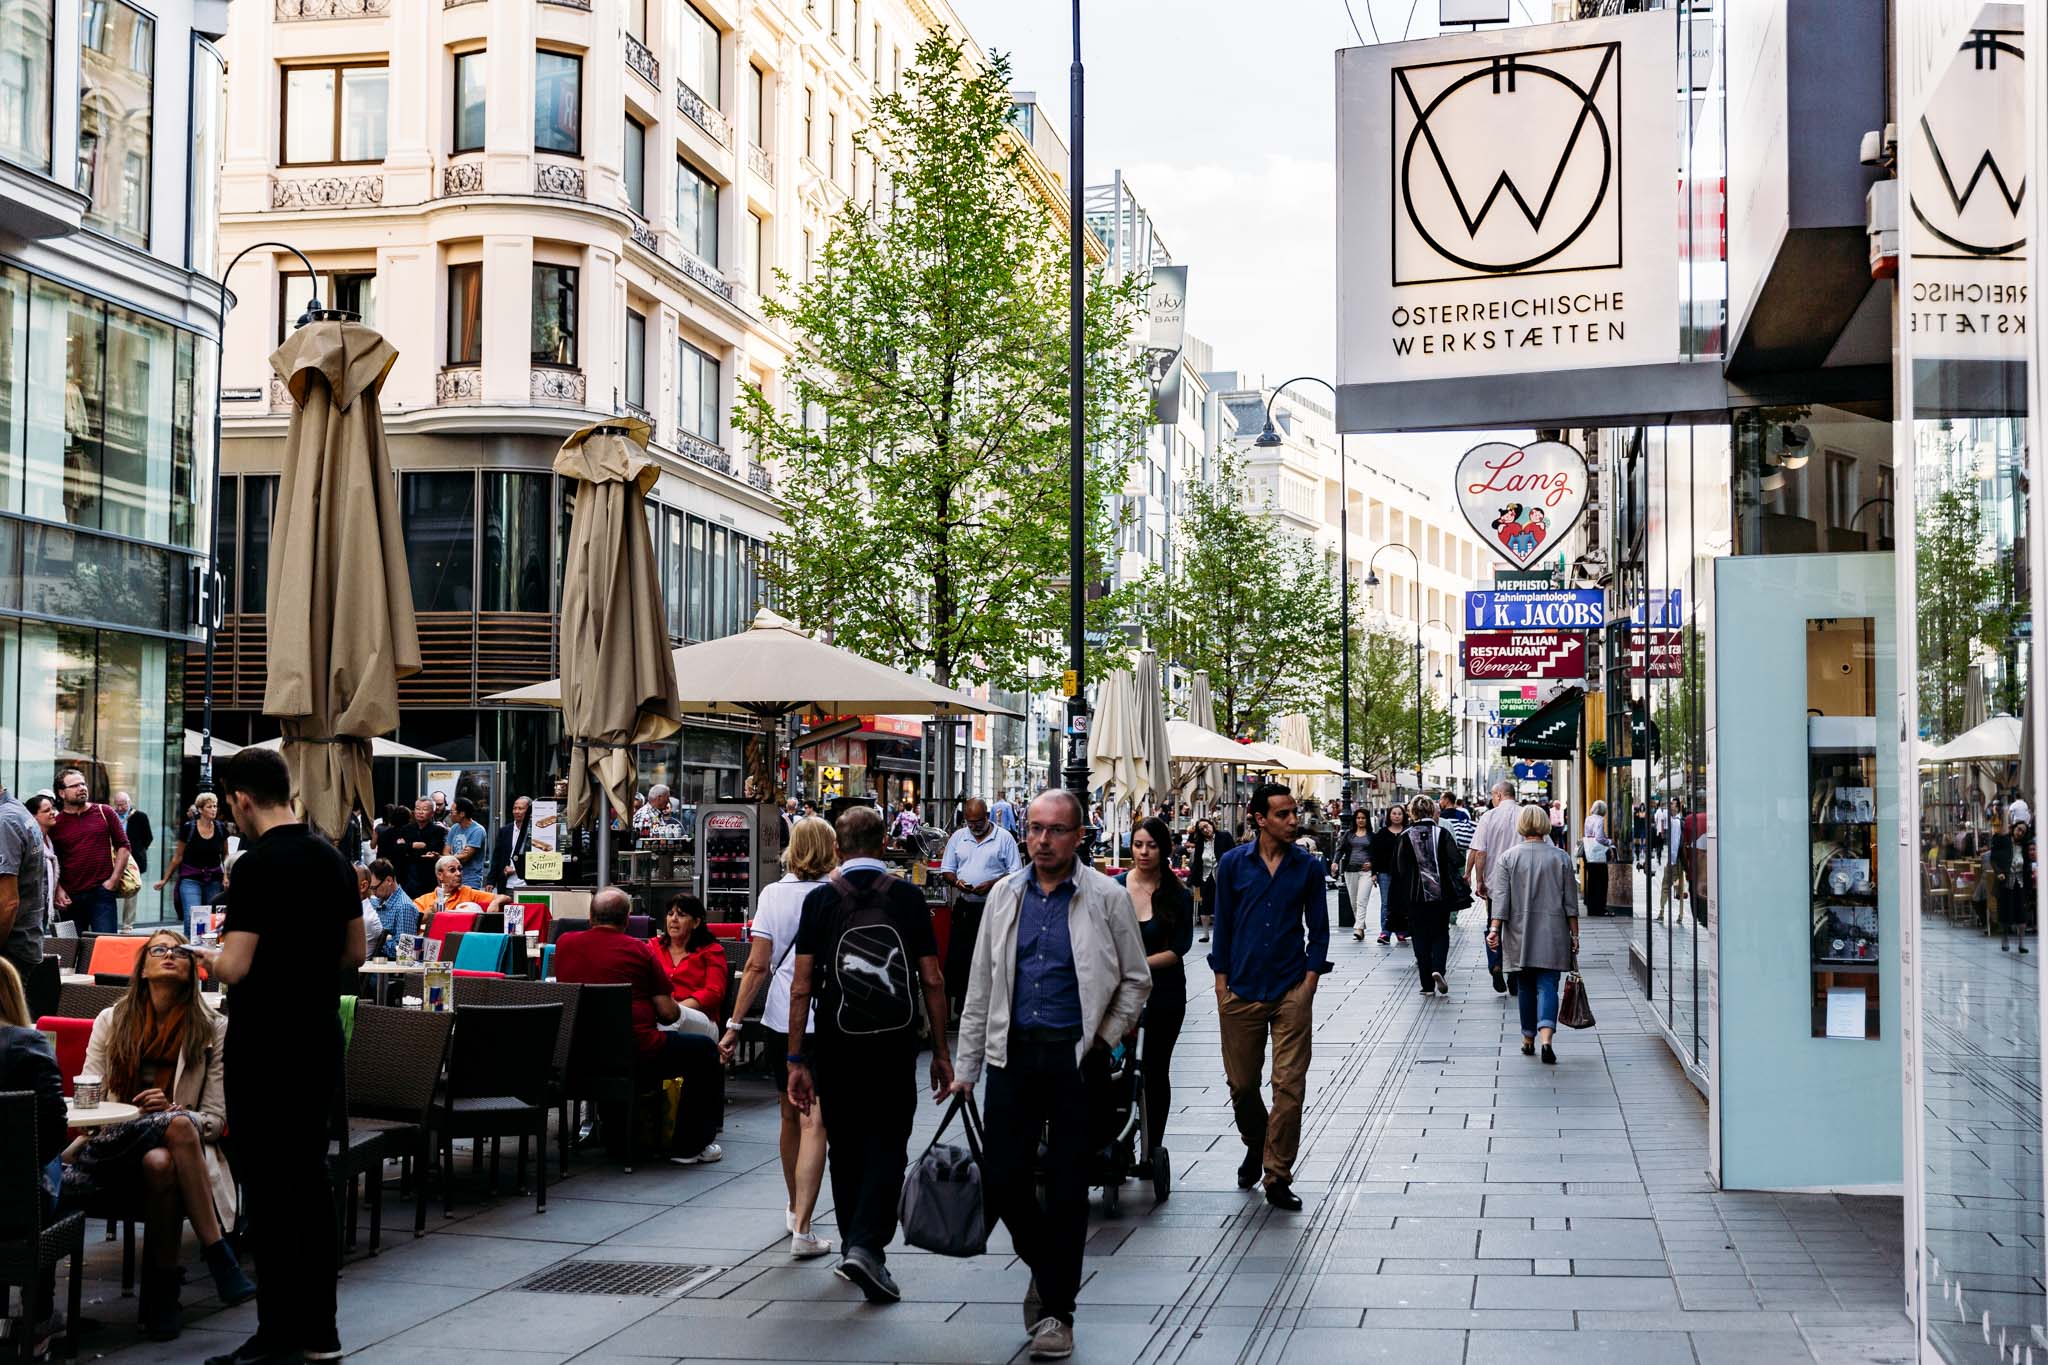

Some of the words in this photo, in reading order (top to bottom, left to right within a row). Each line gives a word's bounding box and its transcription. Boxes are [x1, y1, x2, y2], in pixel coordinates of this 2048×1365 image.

[1155, 293, 1183, 308] sky
[1392, 291, 1624, 327] ÖSTERREICHISCHE
[1155, 315, 1180, 323] BAR
[1392, 321, 1624, 356] WERKSTÆTTEN
[1468, 451, 1573, 507] Lanz
[1497, 580, 1549, 590] MEPHISTO
[1493, 591, 1577, 603] Zahnimplantologie
[1494, 604, 1516, 627] K.
[1520, 602, 1603, 626] JACOBS
[1511, 636, 1558, 646] ITALIAN
[1470, 646, 1548, 657] RESTAURANT
[1470, 657, 1532, 678] Venezia
[708, 815, 745, 828] Coca-Cola
[530, 860, 557, 871] Sturm
